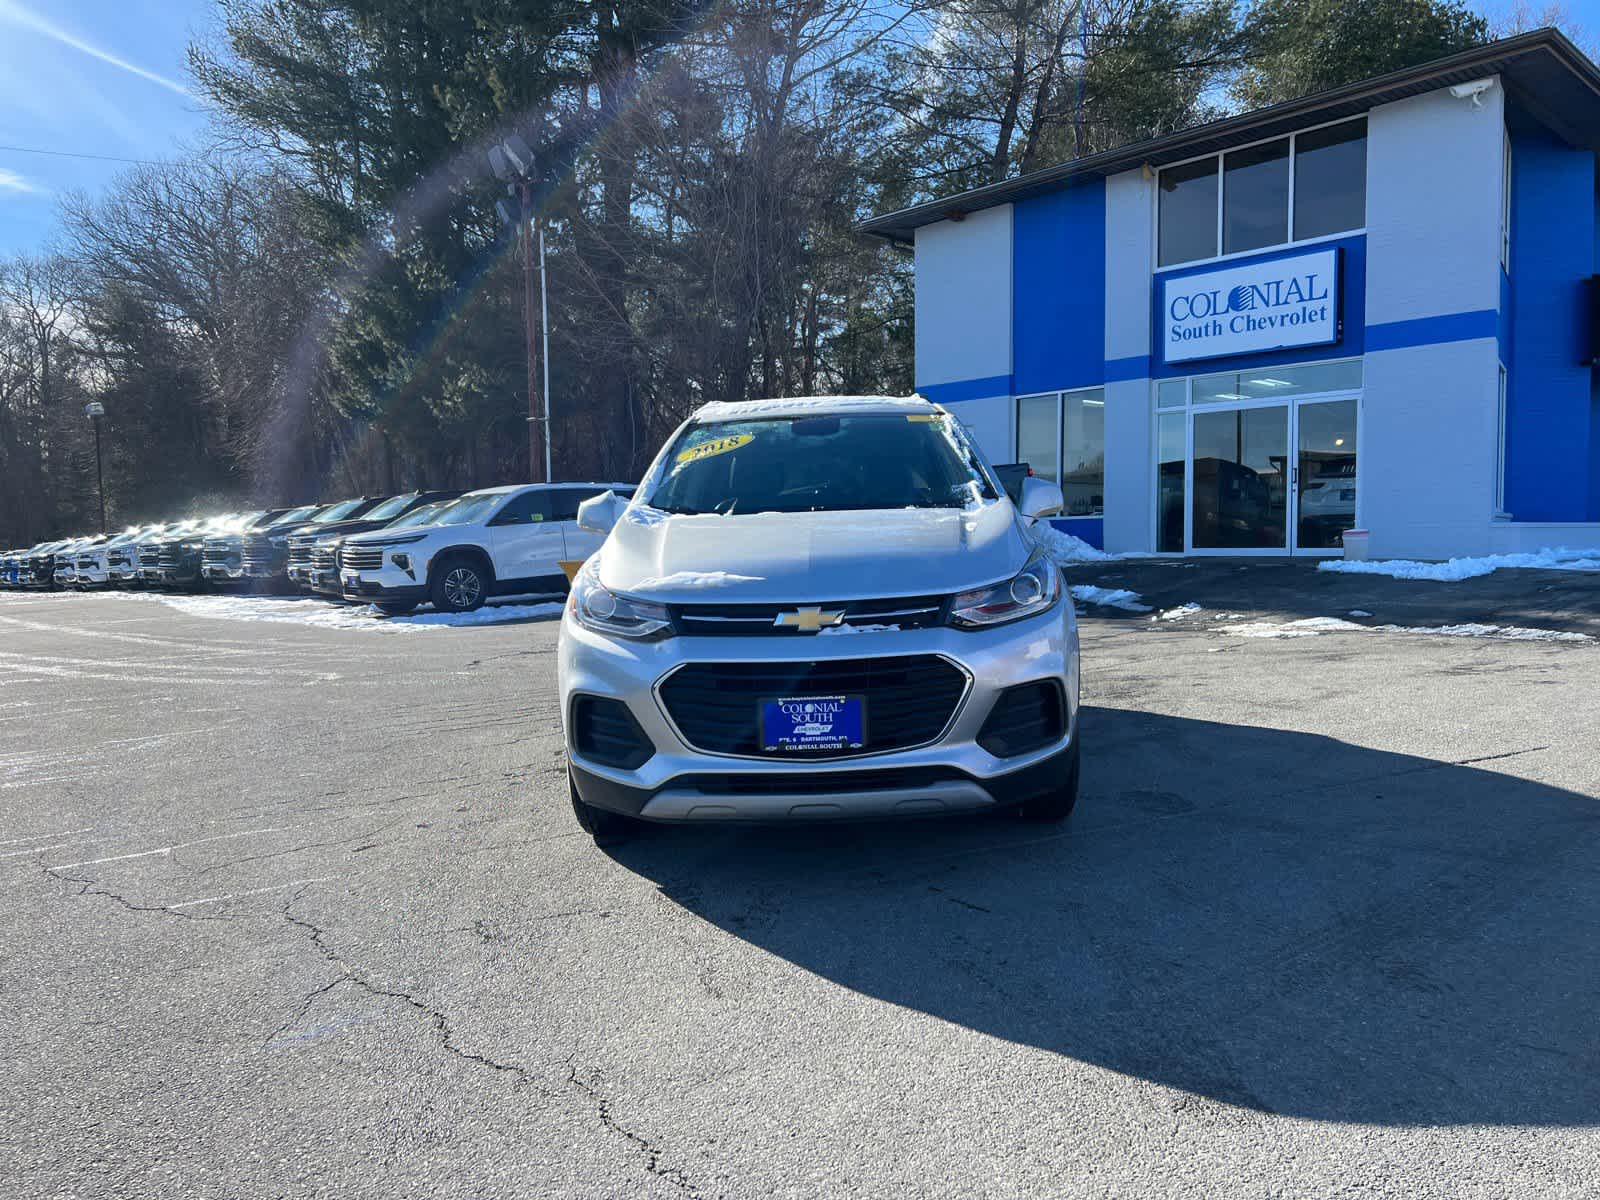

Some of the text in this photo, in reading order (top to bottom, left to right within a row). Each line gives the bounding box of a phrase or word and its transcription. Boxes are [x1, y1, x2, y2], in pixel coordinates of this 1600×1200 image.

[1170, 274, 1328, 322] COLONIAL
[1171, 305, 1328, 342] South Chevrolet
[694, 435, 739, 456] 2018
[782, 702, 843, 714] COLONIAL
[791, 712, 833, 724] SOUTH
